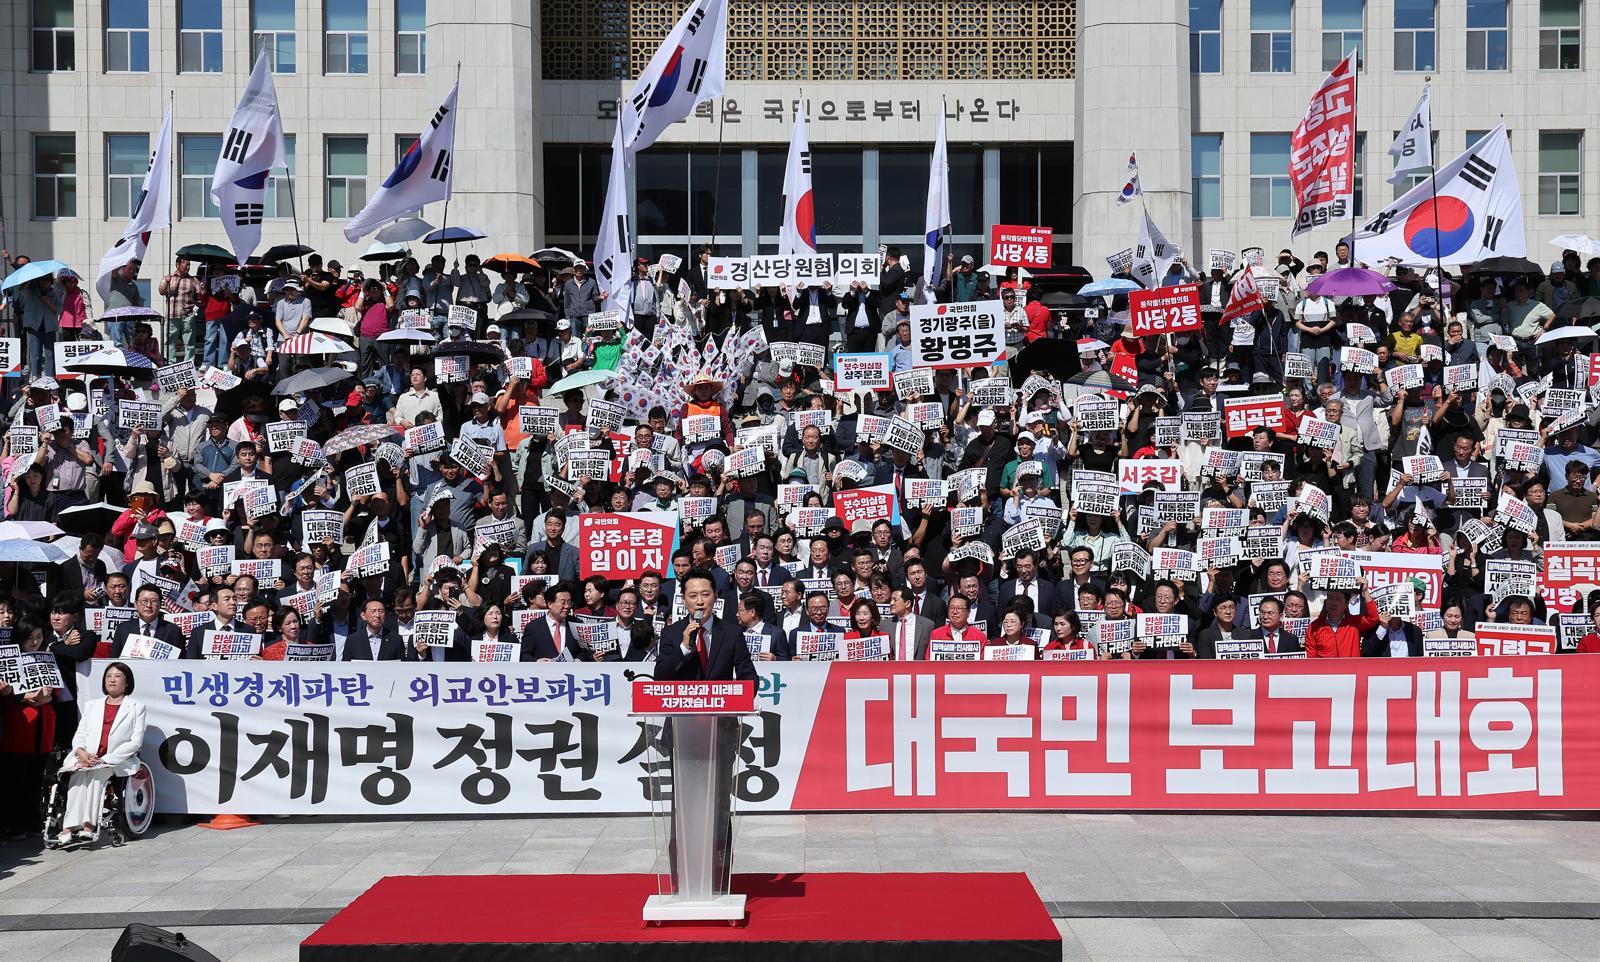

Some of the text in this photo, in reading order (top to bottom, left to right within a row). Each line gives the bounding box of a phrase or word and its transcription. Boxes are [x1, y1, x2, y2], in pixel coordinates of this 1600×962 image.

[949, 304, 977, 313] 국민의힘
[920, 314, 995, 333] 경기광주(을)
[920, 334, 997, 362] 황명주
[844, 362, 882, 370] 보수의심장
[844, 370, 883, 380] 상주문경
[913, 403, 939, 413] 민생파탄
[122, 412, 158, 421] 대통령은
[522, 417, 556, 427] 대통령은
[591, 409, 622, 424] 대통령은
[799, 412, 829, 423] 민생파탄
[913, 411, 939, 422] 헌정파괴
[1080, 412, 1116, 422] 대통령은
[1228, 407, 1283, 431] 칠곡군
[523, 425, 555, 434] 사죄하라
[1080, 420, 1116, 430] 사죄하라
[1186, 422, 1217, 431] 대통령은
[1308, 419, 1337, 431] 민생파탄
[1305, 426, 1336, 439] 헌정파괴
[1210, 450, 1239, 460] 민생파탄
[1513, 445, 1541, 457] 민생파탄
[1207, 458, 1237, 468] 헌정파괴
[1410, 457, 1438, 468] 민생파탄
[1511, 453, 1540, 463] 헌정파괴
[571, 461, 605, 471] 대통령은
[1411, 464, 1438, 474] 헌정파괴
[1505, 460, 1519, 471] 강력
[1122, 464, 1178, 484] 서초갑
[1201, 466, 1214, 477] 강력
[912, 481, 942, 491] 민생파탄
[911, 488, 942, 499] 헌정파괴
[1078, 493, 1115, 504] 대통령은
[843, 495, 887, 509] 보수의심장
[906, 498, 919, 509] 강력
[845, 506, 888, 521] 상주문경
[1077, 502, 1112, 514] 사죄하라
[1158, 503, 1196, 513] 대통령은
[798, 509, 829, 519] 민생파탄
[1157, 511, 1195, 522] 사죄하라
[1209, 509, 1243, 519] 민생파탄
[1494, 512, 1508, 524] 강력
[306, 522, 341, 533] 대통령은
[1208, 518, 1242, 527] 헌정파괴
[589, 528, 663, 547] 상주·문경
[1202, 526, 1247, 538] 강력 규탄한다
[1003, 529, 1038, 547] 대통령은
[1201, 539, 1231, 549] 민생파탄
[1161, 551, 1193, 560] 민생파탄
[1201, 547, 1231, 558] 헌정파괴
[1242, 547, 1280, 559] 사죄하라
[240, 560, 274, 571] 민생파탄
[1160, 559, 1192, 569] 헌정파괴
[1320, 557, 1355, 567] 민생파탄
[1319, 566, 1355, 577] 헌정파괴
[1547, 555, 1600, 581] 칠곡
[1154, 569, 1197, 582] 강력 규탄한다
[1312, 577, 1328, 590] 강력
[1145, 615, 1180, 626] 민생파탄
[415, 623, 449, 635] 대통령은
[576, 624, 609, 634] 민생파탄
[1100, 621, 1130, 632] 민생파탄
[1144, 625, 1180, 635] 헌정파괴
[213, 633, 253, 644] 민생파탄
[801, 634, 836, 644] 민생파탄
[1100, 630, 1130, 642] 헌정파괴
[1155, 635, 1187, 647] 규탄한다
[212, 643, 252, 653] 헌정파괴
[480, 644, 513, 654] 민생파탄
[801, 642, 835, 653] 헌정파괴
[847, 638, 882, 650] 민생파탄
[847, 647, 882, 660] 헌정파괴
[161, 671, 611, 707] 민생경제파탄 외교안보파괴
[643, 684, 744, 696] 국민의 일상과 미래를
[661, 697, 725, 708] 지키겠습니다
[845, 667, 1564, 798] 대국민 보고대회
[158, 711, 414, 806] 이재명
[432, 712, 602, 804] 정권
